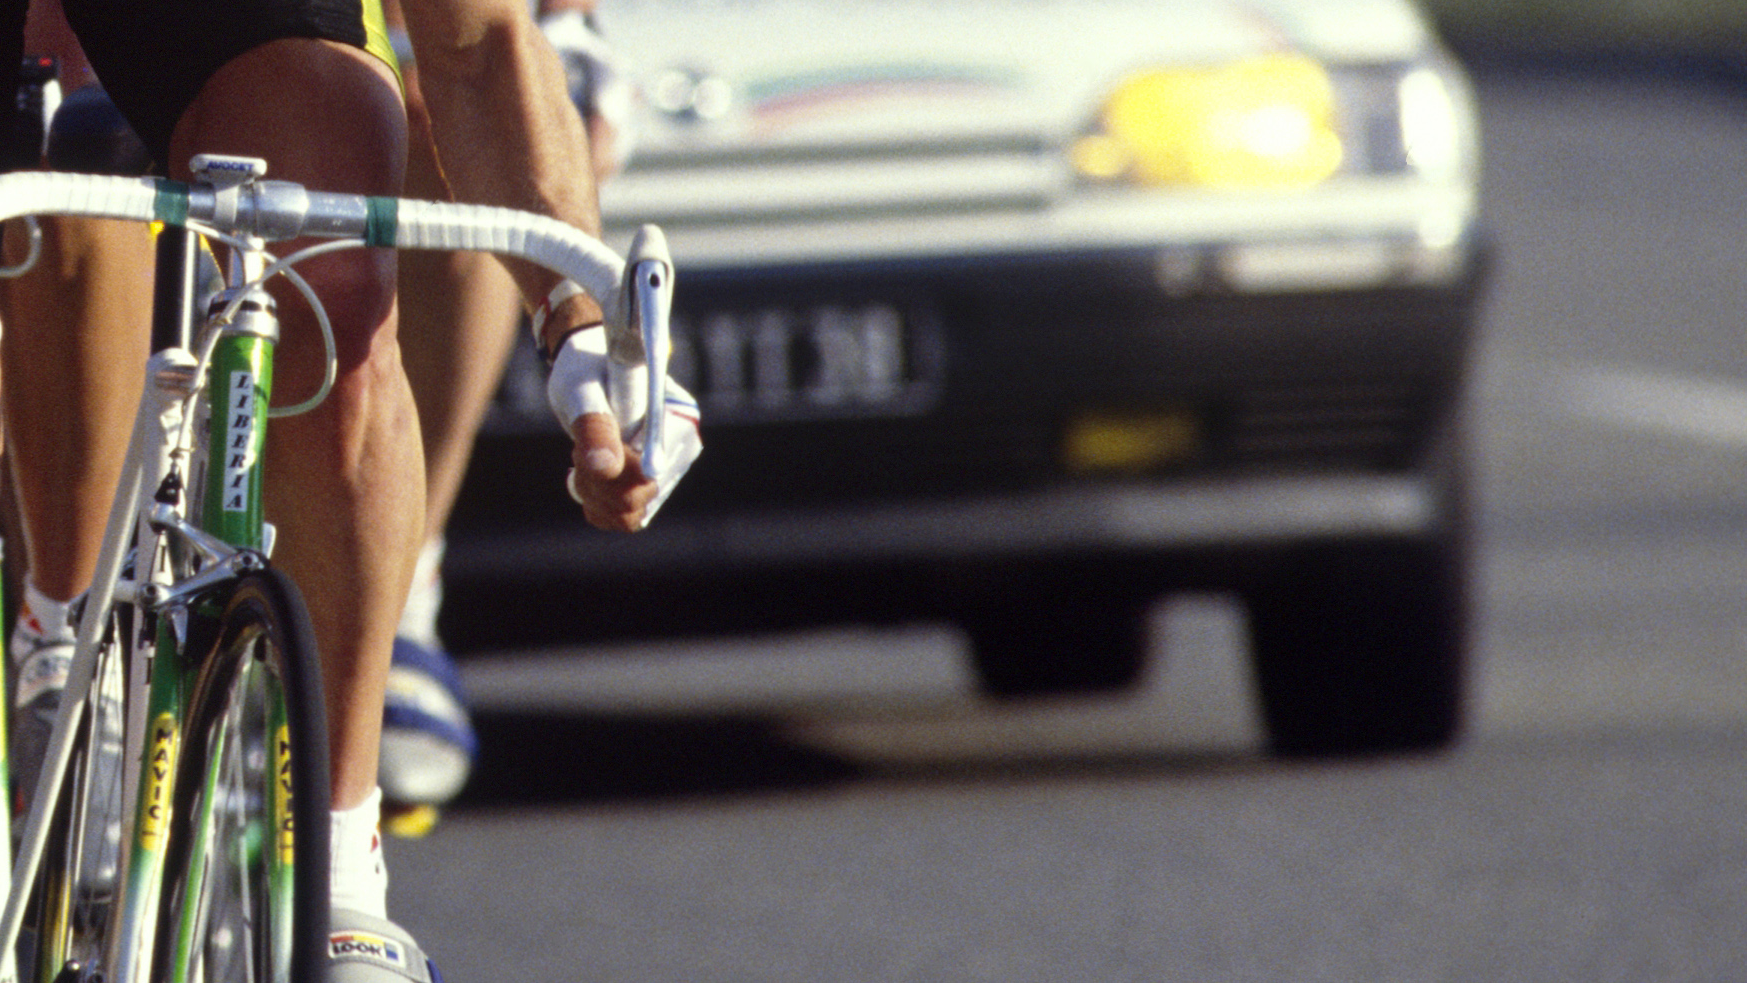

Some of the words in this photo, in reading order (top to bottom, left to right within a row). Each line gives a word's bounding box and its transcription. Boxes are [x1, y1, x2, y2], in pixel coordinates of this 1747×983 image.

[226, 374, 251, 509] LIBERIA
[148, 727, 174, 820] MAVIC
[333, 943, 383, 957] LOOK
